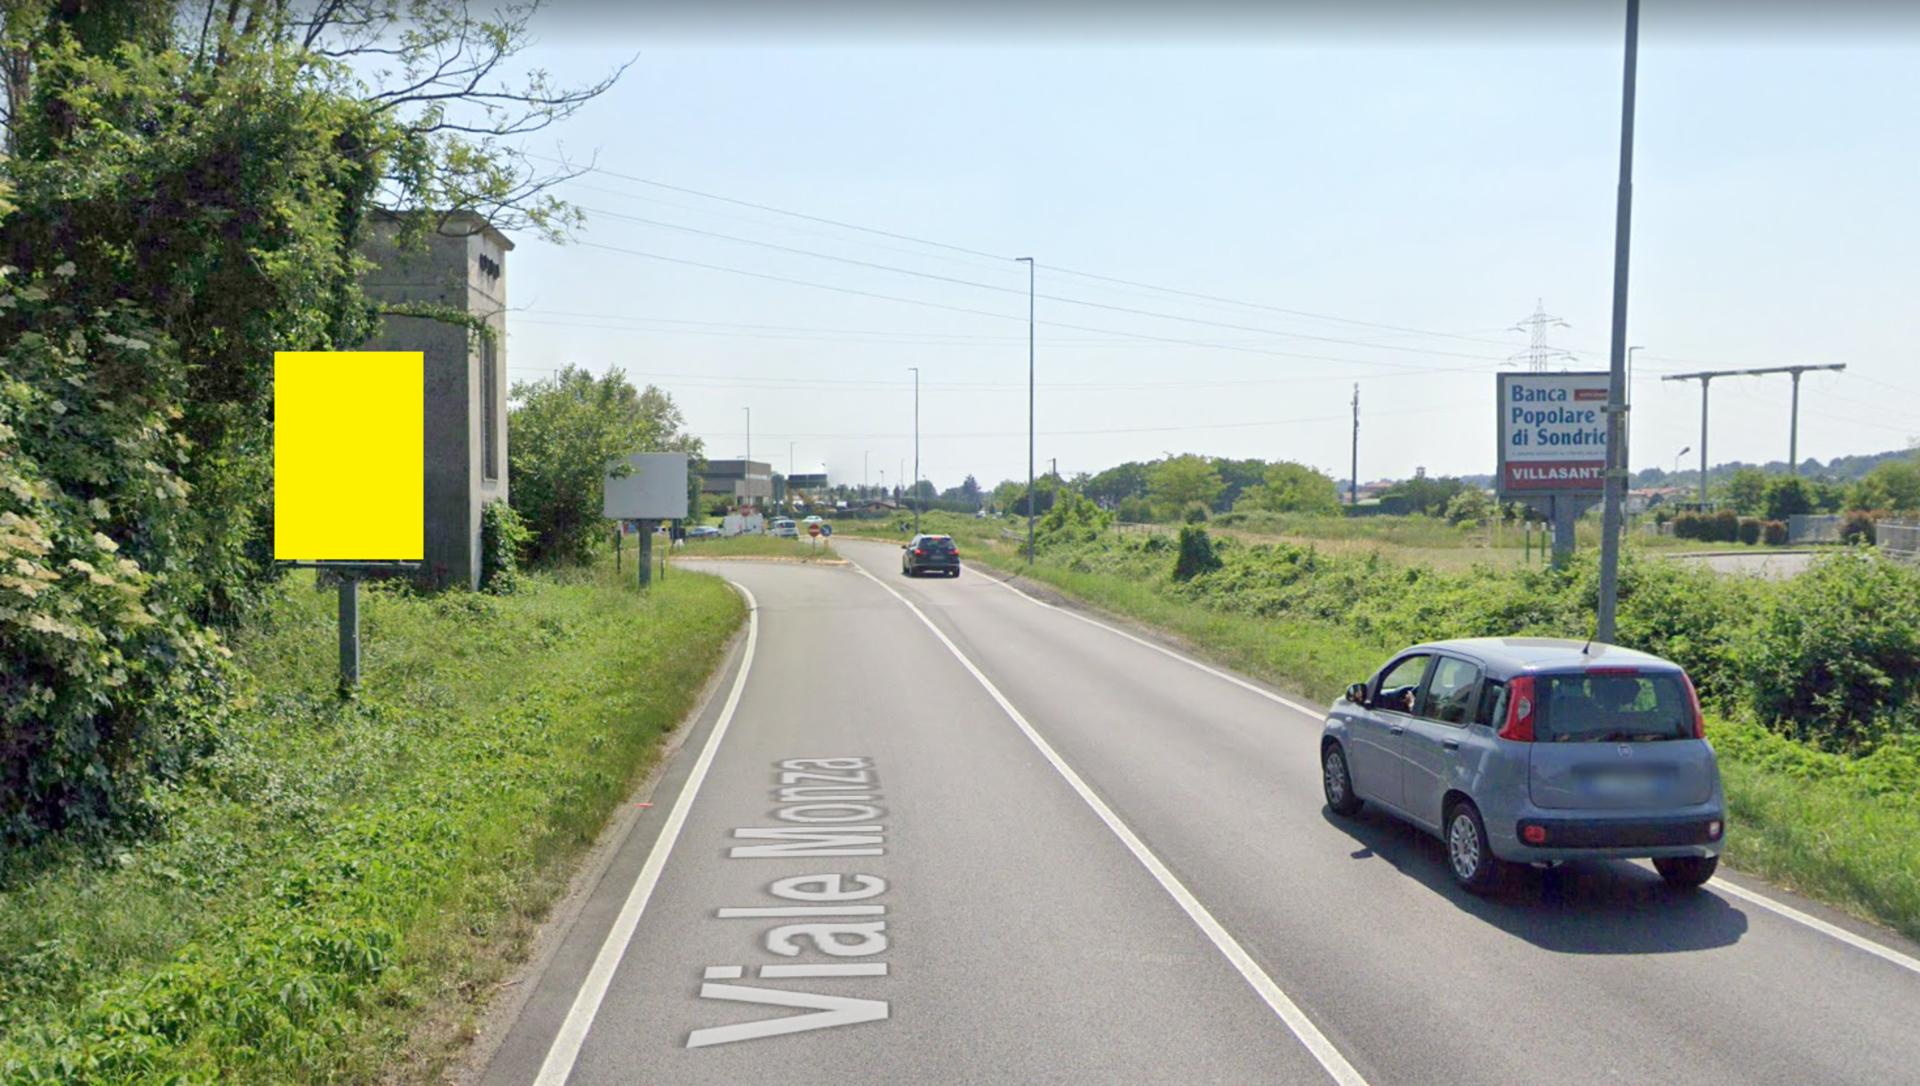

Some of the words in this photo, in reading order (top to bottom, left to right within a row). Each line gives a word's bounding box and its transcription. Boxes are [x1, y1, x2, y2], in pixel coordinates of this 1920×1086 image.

[1512, 385, 1567, 402] Banca
[1512, 407, 1596, 427] Popolare
[1512, 429, 1529, 446] di
[1512, 467, 1605, 480] VILLASANT
